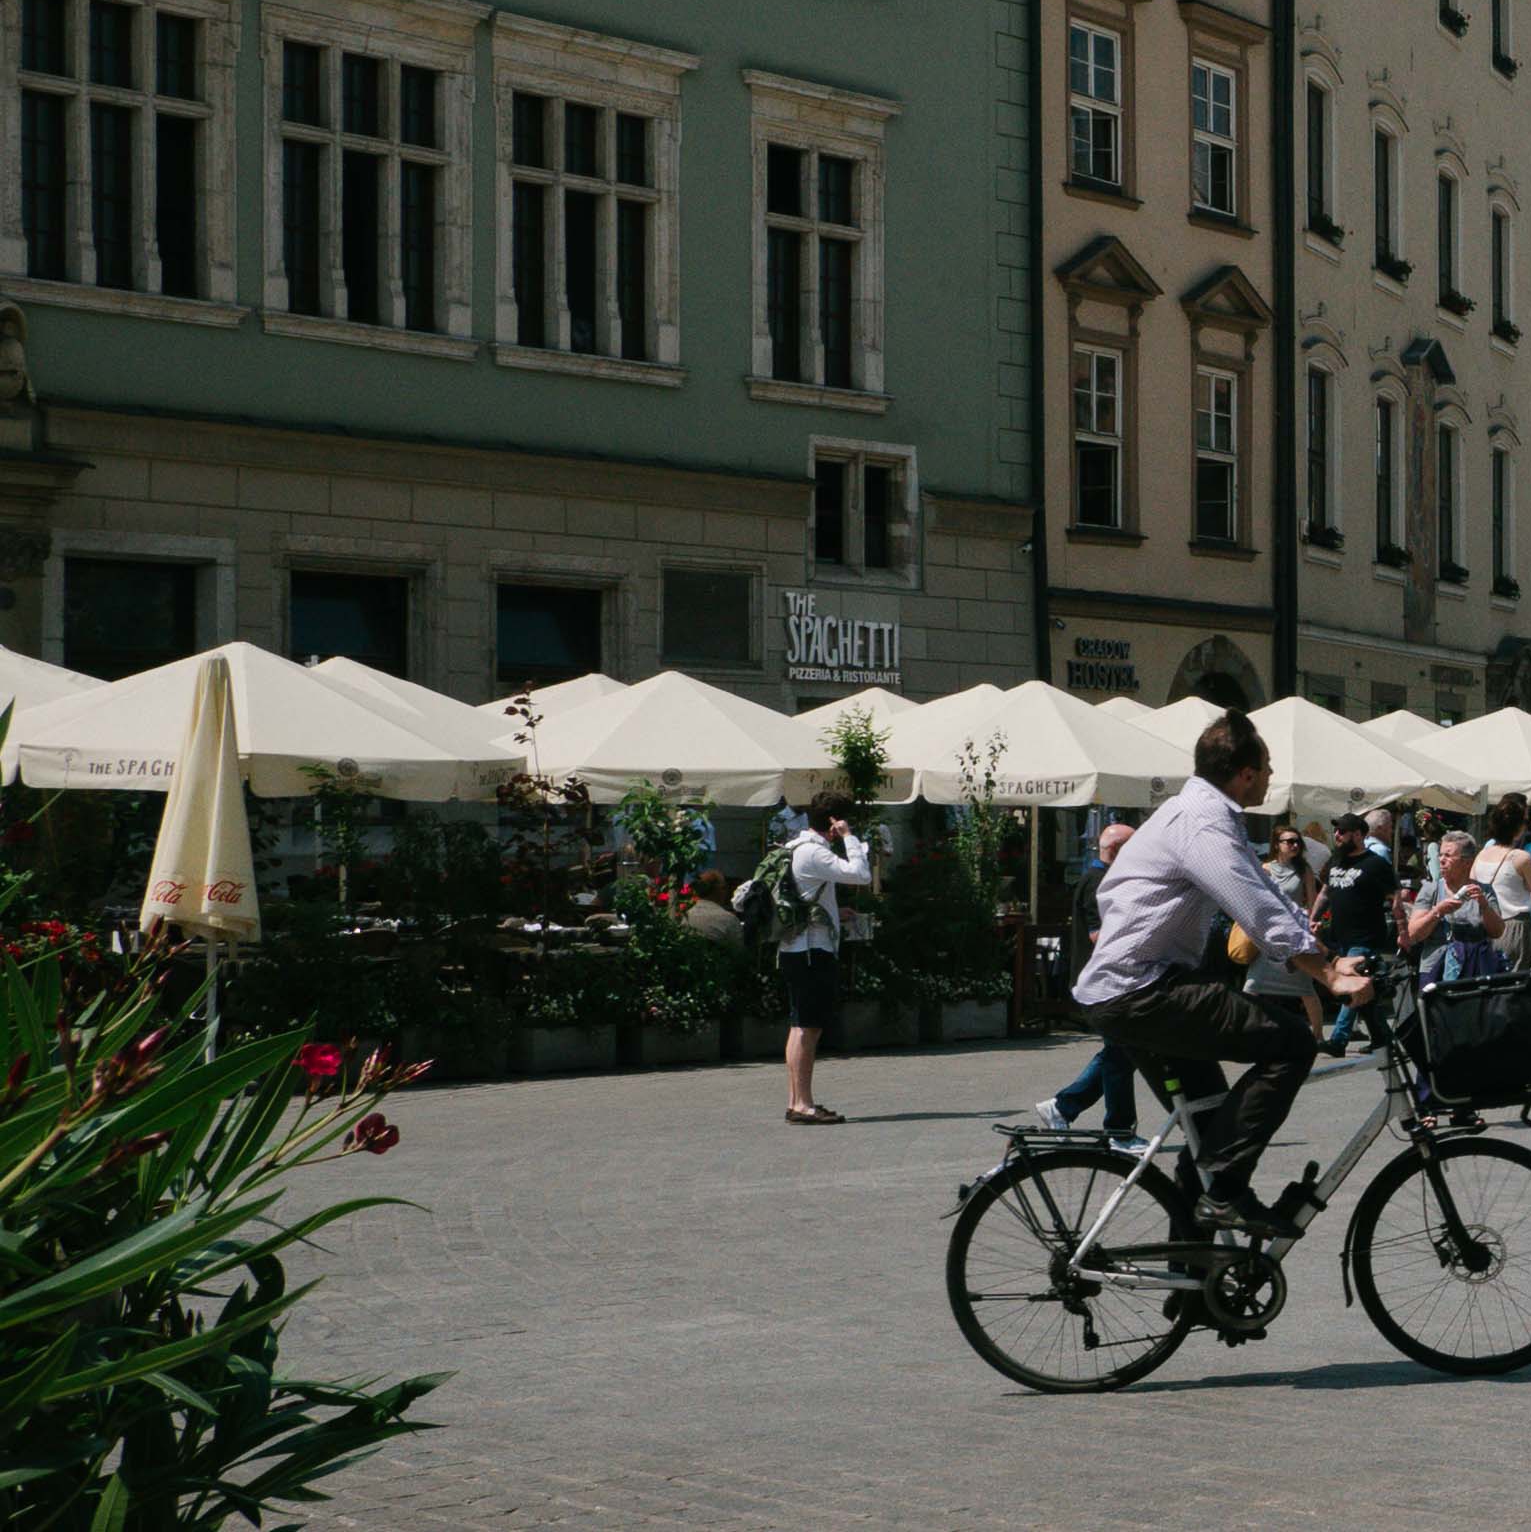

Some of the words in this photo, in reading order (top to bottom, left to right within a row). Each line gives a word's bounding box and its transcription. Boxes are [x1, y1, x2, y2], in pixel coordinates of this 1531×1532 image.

[785, 591, 817, 617] THE
[786, 615, 900, 669] SPAGHETTI
[788, 667, 832, 681] PIZZERIA
[832, 670, 841, 682] &
[842, 670, 901, 685] RISTORANTE
[1066, 659, 1140, 691] HOSTEL
[90, 762, 112, 774] THE
[117, 759, 175, 776] SPAGH
[999, 779, 1075, 796] SPAGHETTI
